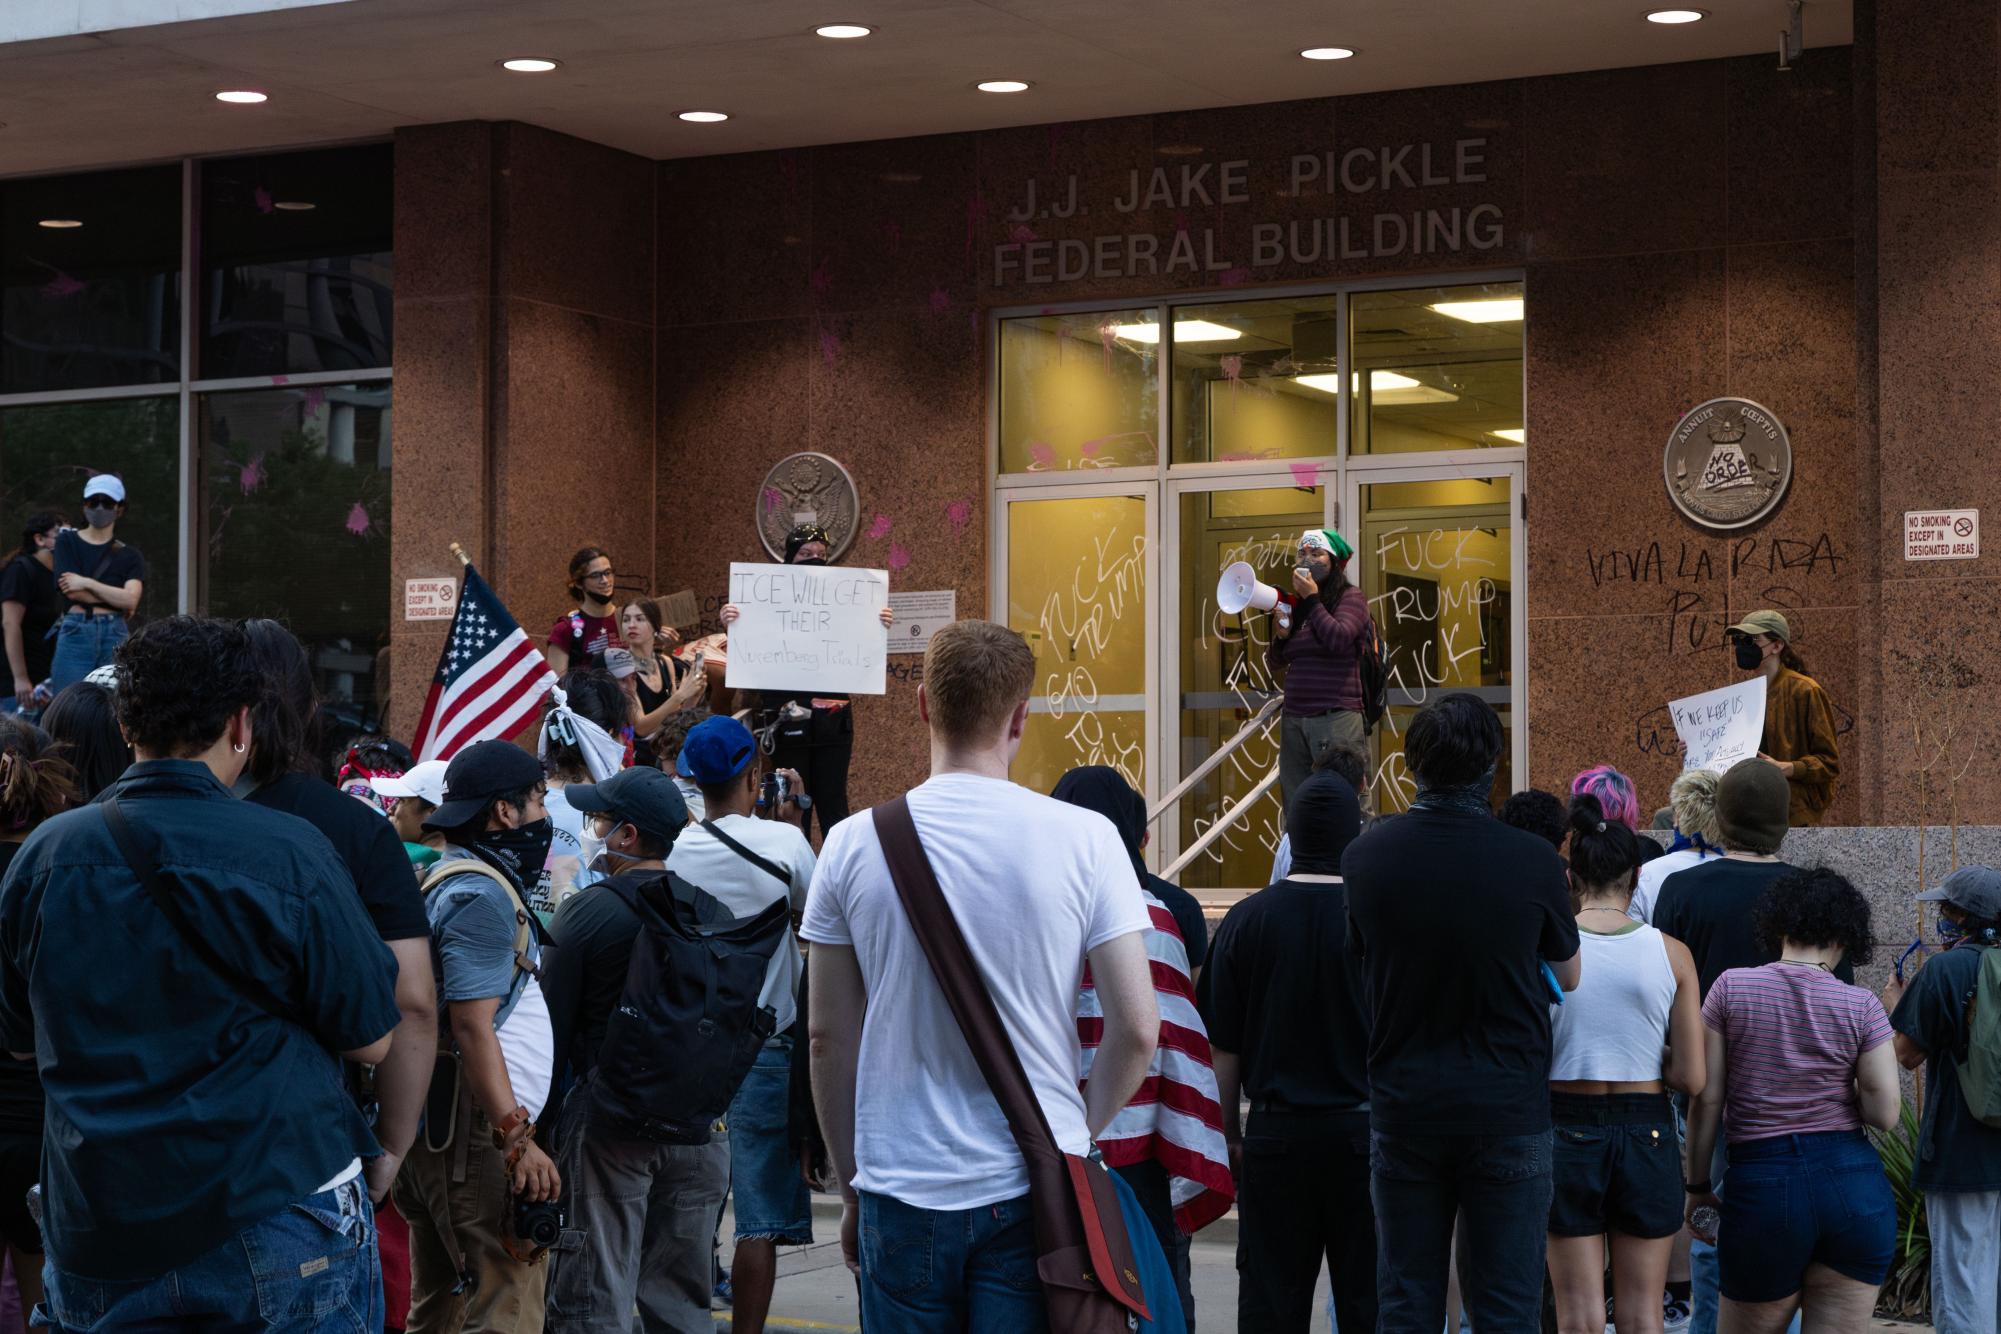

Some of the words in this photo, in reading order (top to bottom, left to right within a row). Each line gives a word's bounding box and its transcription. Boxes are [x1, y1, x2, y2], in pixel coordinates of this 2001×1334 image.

[1010, 175, 1088, 222] J.J.
[1114, 160, 1250, 213] JAKE
[1291, 138, 1488, 196] PICKLE
[994, 229, 1233, 286] FEDERAL
[1252, 203, 1504, 267] BUILDING
[1679, 407, 1714, 443] ANNUIT
[1705, 453, 1765, 484] ORDER
[1709, 452, 1734, 469] NO
[1909, 516, 1919, 528] NO
[1921, 515, 1951, 527] SMOKING
[1909, 531, 1935, 542] EXCEPT
[1937, 530, 1944, 541] IN
[1376, 526, 1495, 571] FUCK
[1909, 544, 1950, 556] DESIGNATED
[1952, 543, 1974, 555] AREAS
[1587, 542, 1665, 587] VIVA
[1678, 543, 1712, 584] LA
[409, 583, 416, 592] NO
[417, 583, 438, 592] SMOKING
[733, 572, 785, 604] ICE
[792, 573, 830, 606] WILL
[834, 579, 881, 606] GET
[409, 595, 426, 604] EXCEPT
[428, 595, 433, 604] IN
[409, 607, 436, 616] DESIGNATED
[438, 606, 454, 616] AREAS
[775, 610, 832, 632] THEIR
[1367, 577, 1496, 646] TRUMP
[1687, 707, 1702, 726] WE
